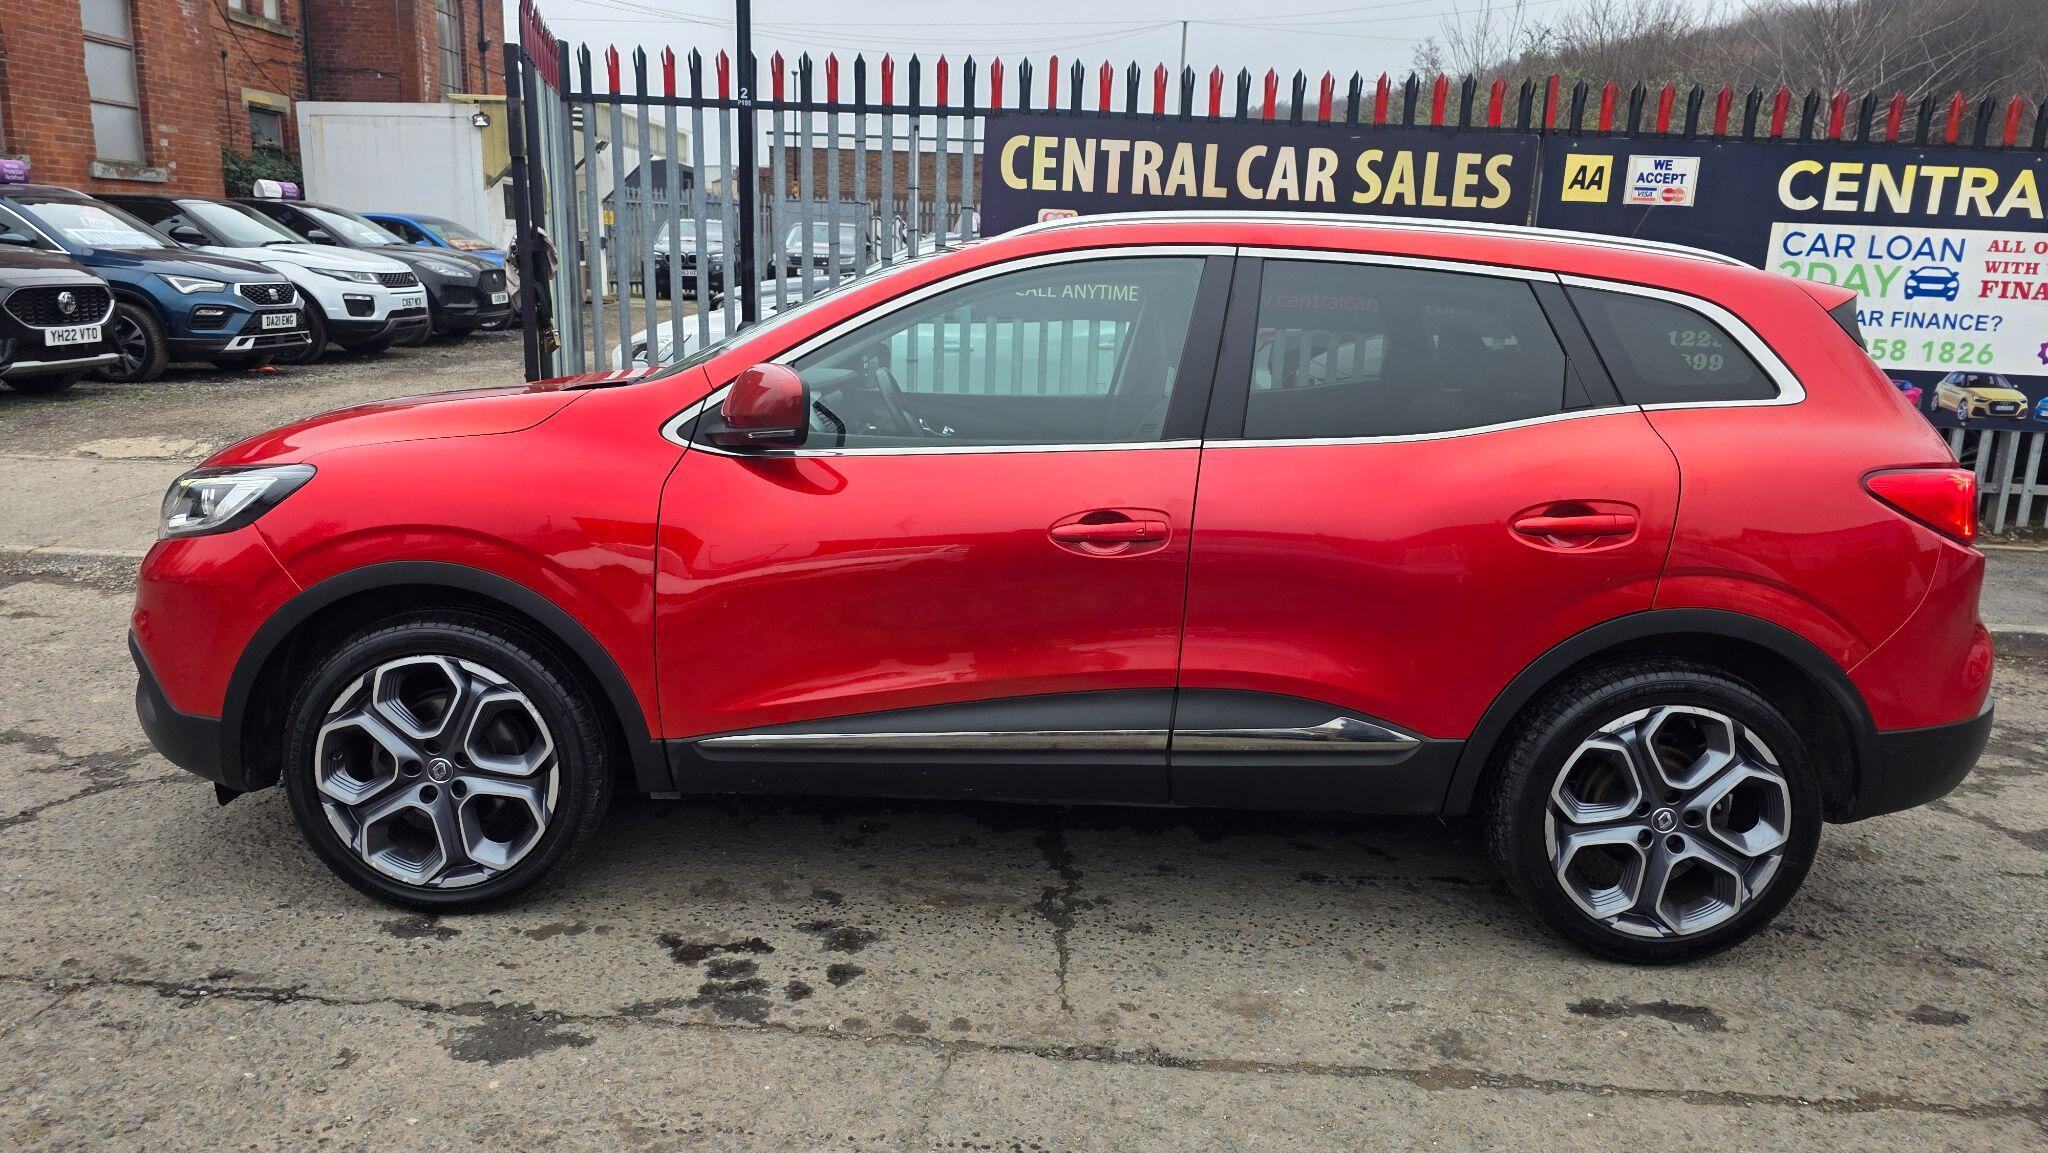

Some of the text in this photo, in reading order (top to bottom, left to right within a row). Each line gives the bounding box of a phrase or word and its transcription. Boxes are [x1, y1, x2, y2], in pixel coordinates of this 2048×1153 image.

[740, 87, 748, 98] 2
[1000, 135, 1514, 209] CENTRAL CAR SALES
[1653, 159, 1674, 171] WE
[1567, 165, 1605, 191] AA
[1636, 172, 1687, 185] ACCEPT
[1777, 159, 2048, 219] CENTRA
[1782, 231, 1966, 262] CAR LOAN
[1986, 239, 2048, 255] ALL O
[1984, 260, 2041, 276] WITH
[1062, 284, 1139, 302] ANYTIME
[266, 316, 281, 327] DA21
[1856, 309, 2004, 332] AR FINANCE?
[50, 327, 98, 344] YH22 VTO
[1863, 338, 1994, 366] 58 1826
